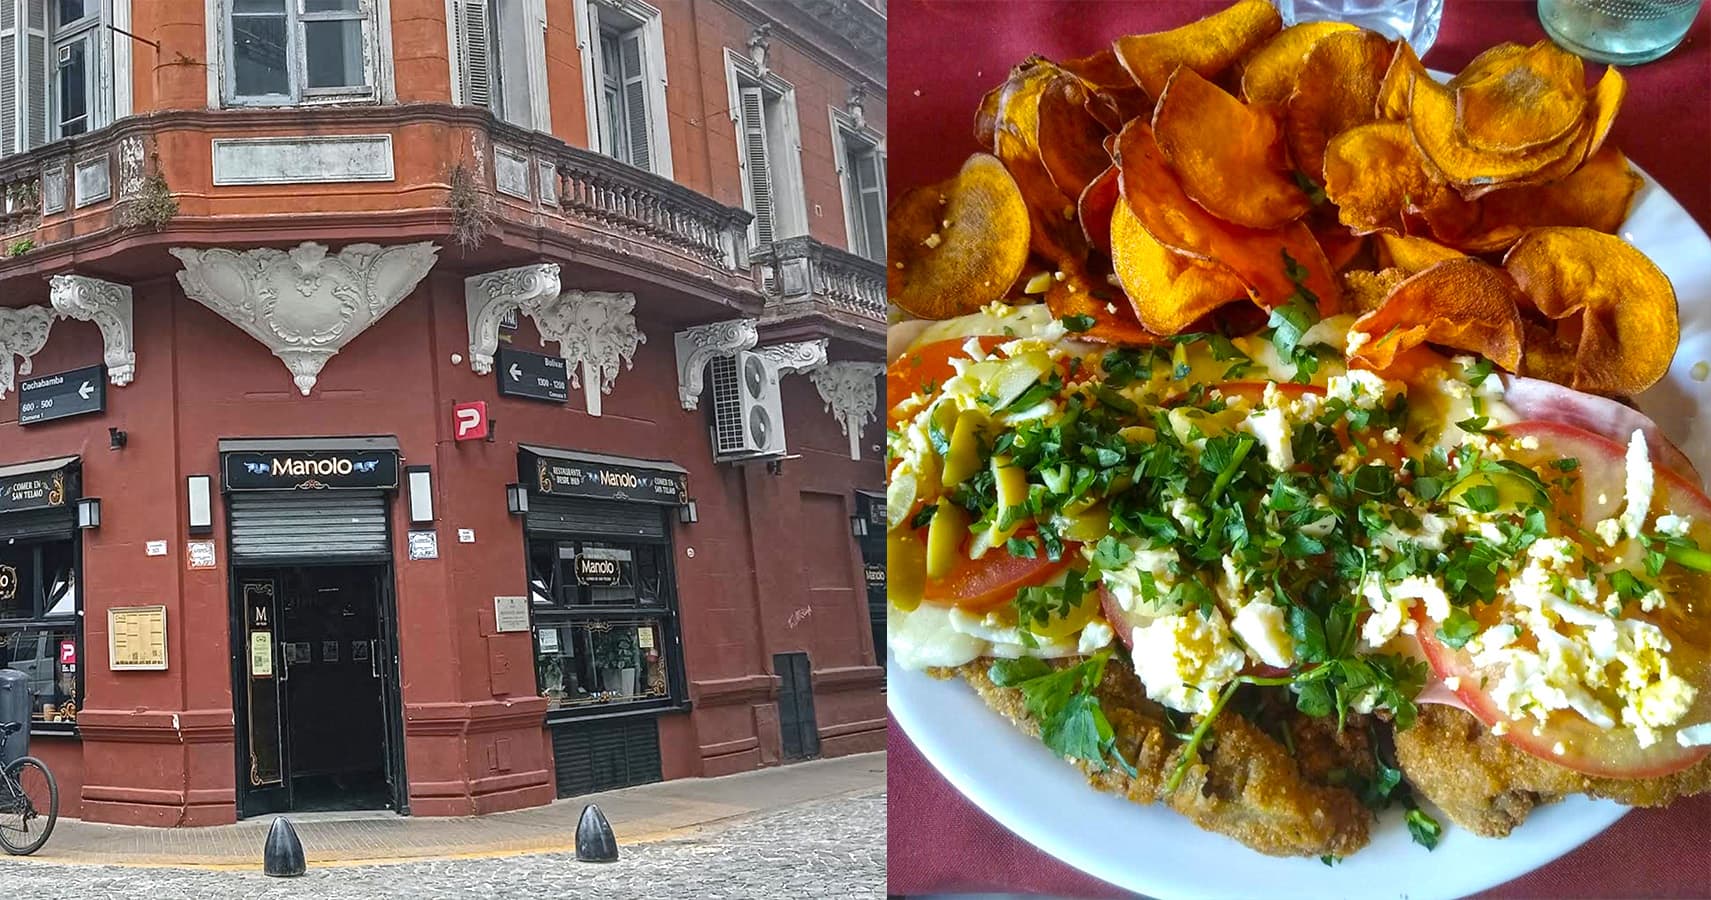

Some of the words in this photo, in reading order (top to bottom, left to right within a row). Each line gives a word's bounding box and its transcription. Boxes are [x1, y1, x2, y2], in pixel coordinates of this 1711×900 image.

[22, 376, 63, 391] Cochabamba
[22, 402, 35, 413] 600
[41, 399, 53, 409] 500
[272, 458, 353, 476] Manolo
[13, 481, 33, 492] COMER
[34, 480, 41, 488] EN
[599, 470, 637, 489] Manolo
[654, 477, 668, 486] COMER
[12, 492, 23, 501] SAN
[24, 489, 43, 499] TELMO
[581, 560, 615, 574] Manolo
[255, 606, 267, 621] M
